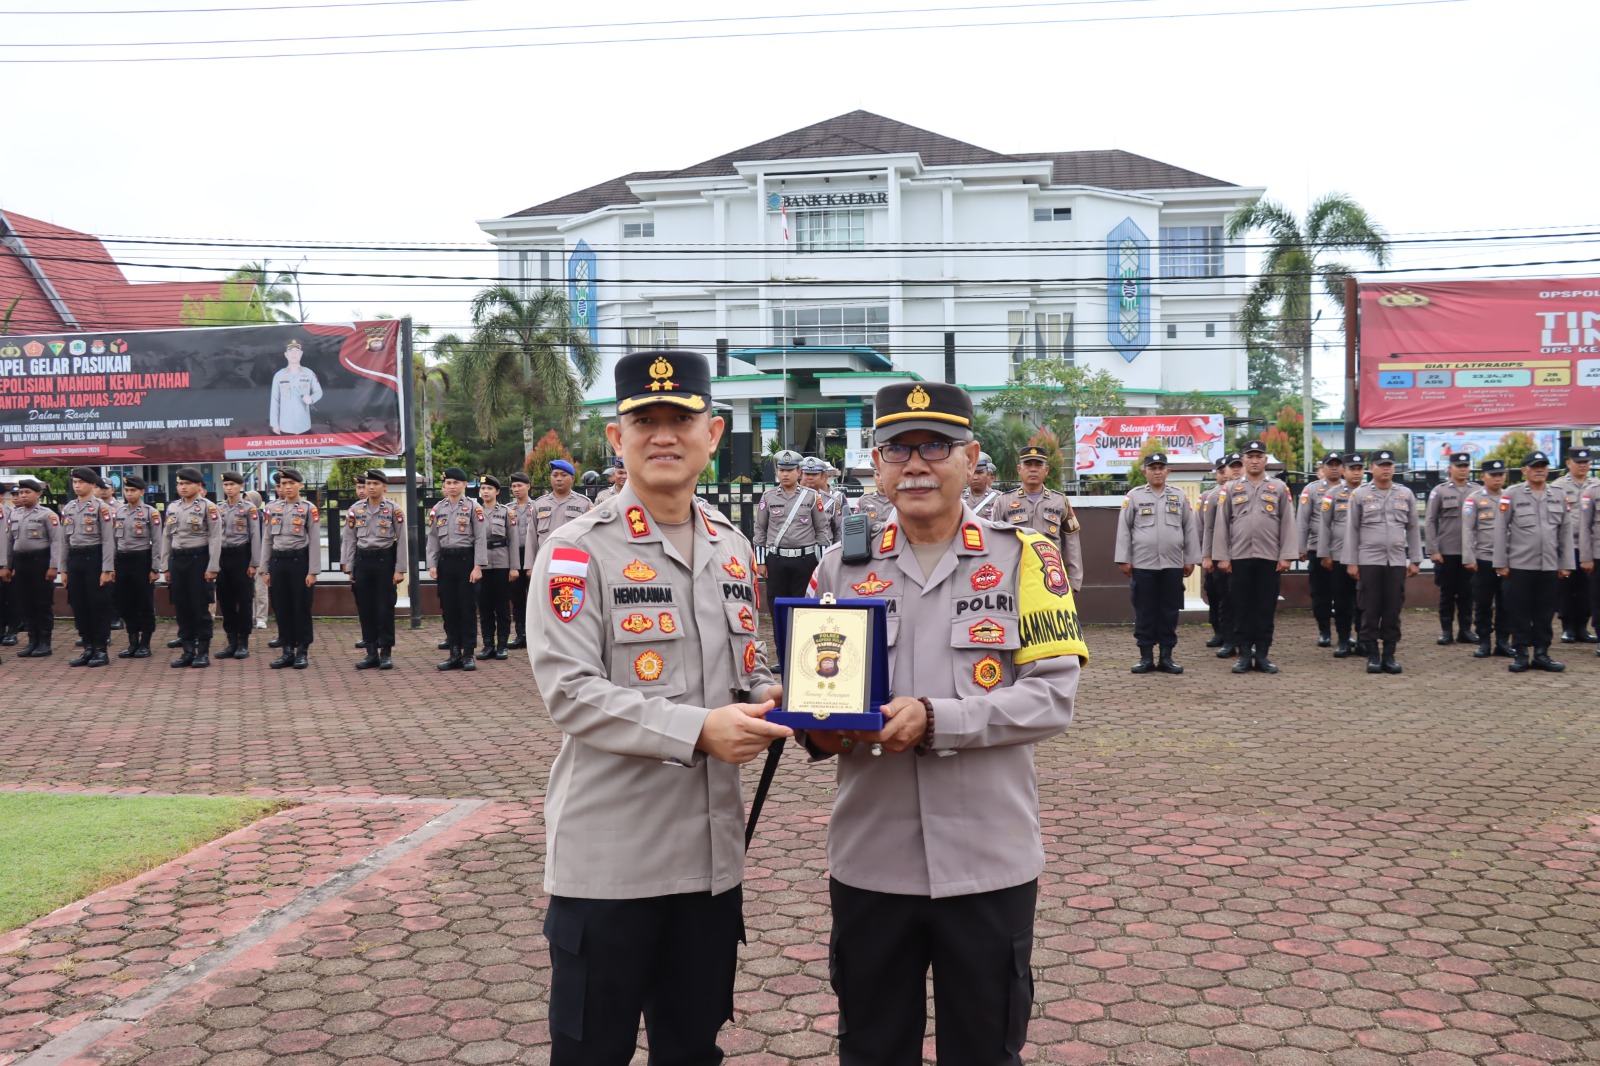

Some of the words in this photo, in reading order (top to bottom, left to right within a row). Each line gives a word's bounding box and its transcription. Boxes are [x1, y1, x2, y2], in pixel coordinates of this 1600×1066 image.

[782, 194, 823, 208] BANK
[826, 192, 888, 206] KALBAR
[30, 357, 69, 375] GELAR
[73, 355, 131, 374] PASUKAN
[57, 375, 106, 392] MANDIRI
[110, 372, 189, 390] KEWILAYAHAN
[33, 394, 67, 409] PRAJA
[29, 409, 60, 420] Dalam
[65, 408, 100, 421] Rangka
[24, 424, 56, 432] GUBERNUR
[57, 423, 94, 431] KALIMANTAN
[96, 422, 115, 430] BARAT
[123, 420, 165, 430] BUPATI/WAKIL
[167, 420, 189, 429] BUPATI
[190, 419, 214, 428] KAPUAS
[1119, 423, 1154, 433] Selamat
[1155, 423, 1177, 432] Hari
[4, 433, 11, 442] DI
[12, 433, 38, 442] WILAYAH
[40, 432, 62, 441] HUKUM
[63, 431, 85, 440] POLRES
[87, 431, 110, 440] KAPUAS
[112, 430, 127, 439] HULU
[1095, 436, 1142, 449] SUMPAH
[554, 576, 581, 585] PROPAM
[613, 586, 673, 604] HENDRAWAN
[957, 594, 1013, 615] POLRI
